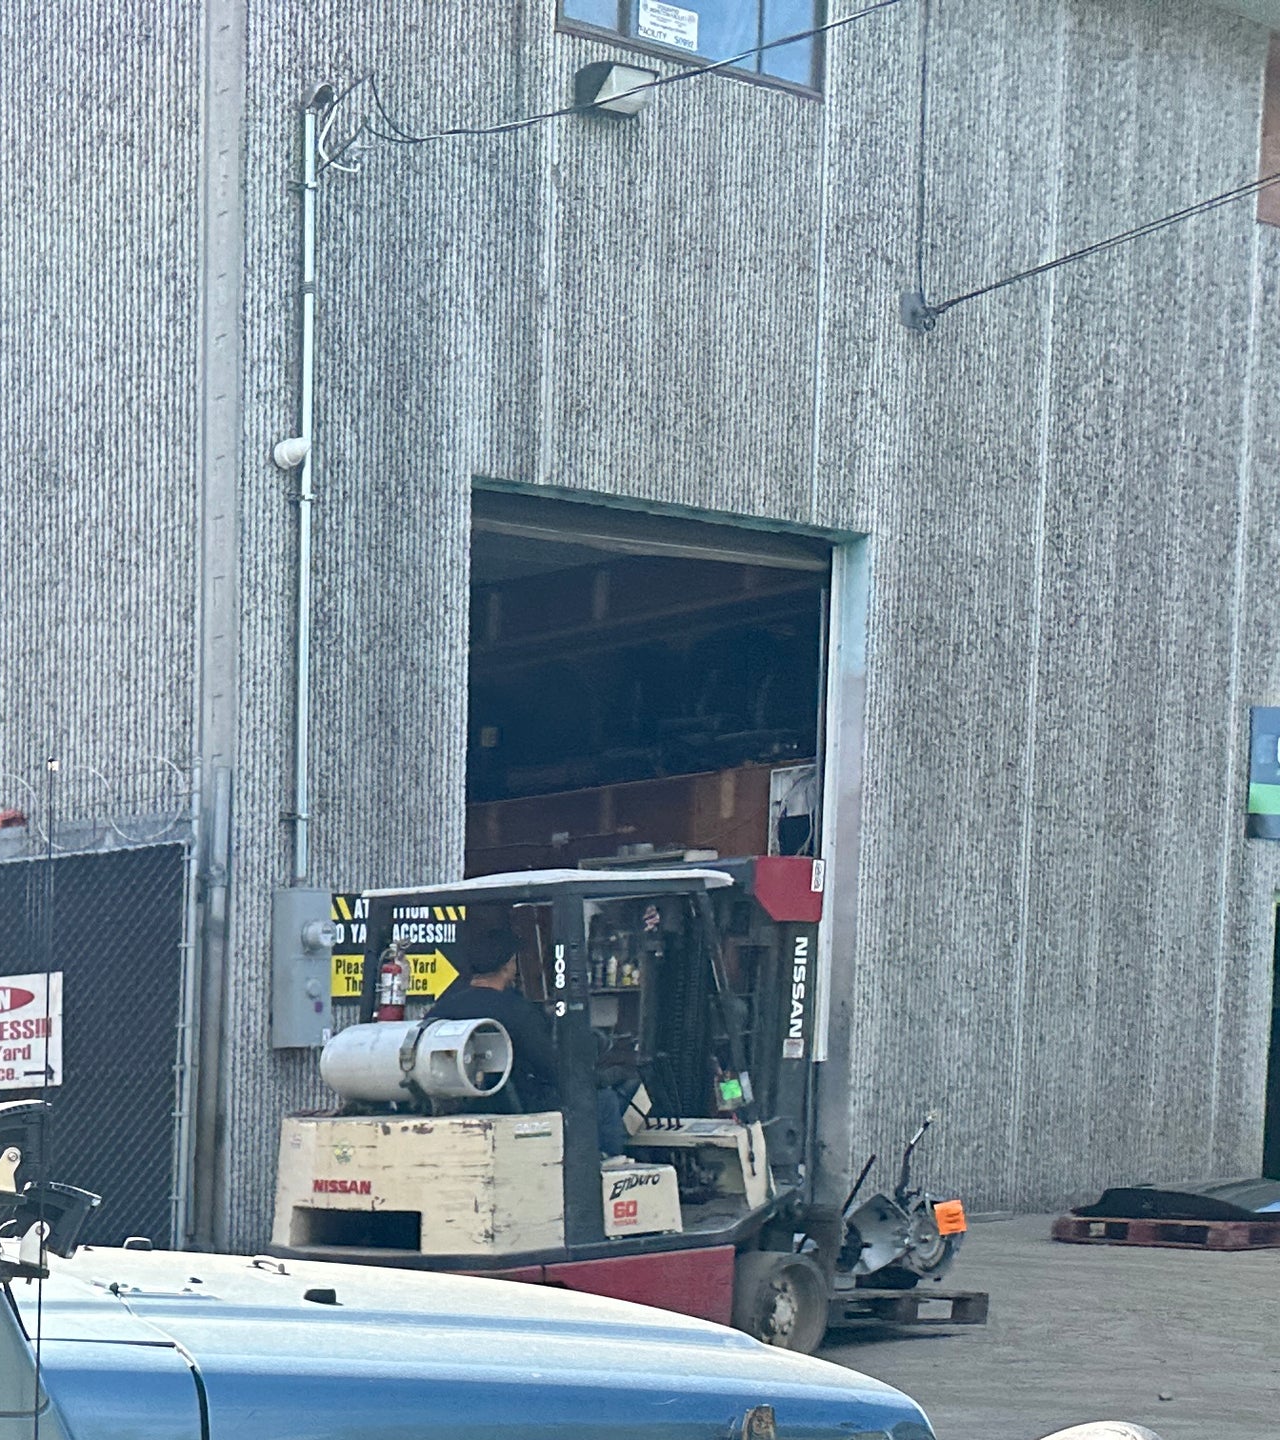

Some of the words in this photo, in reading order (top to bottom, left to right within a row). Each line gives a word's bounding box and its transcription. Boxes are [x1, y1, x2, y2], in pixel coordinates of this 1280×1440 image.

[413, 958, 437, 974] Yard
[788, 936, 809, 1038] NISSAN
[312, 1179, 372, 1195] NISSAN
[613, 1200, 638, 1219] 60
